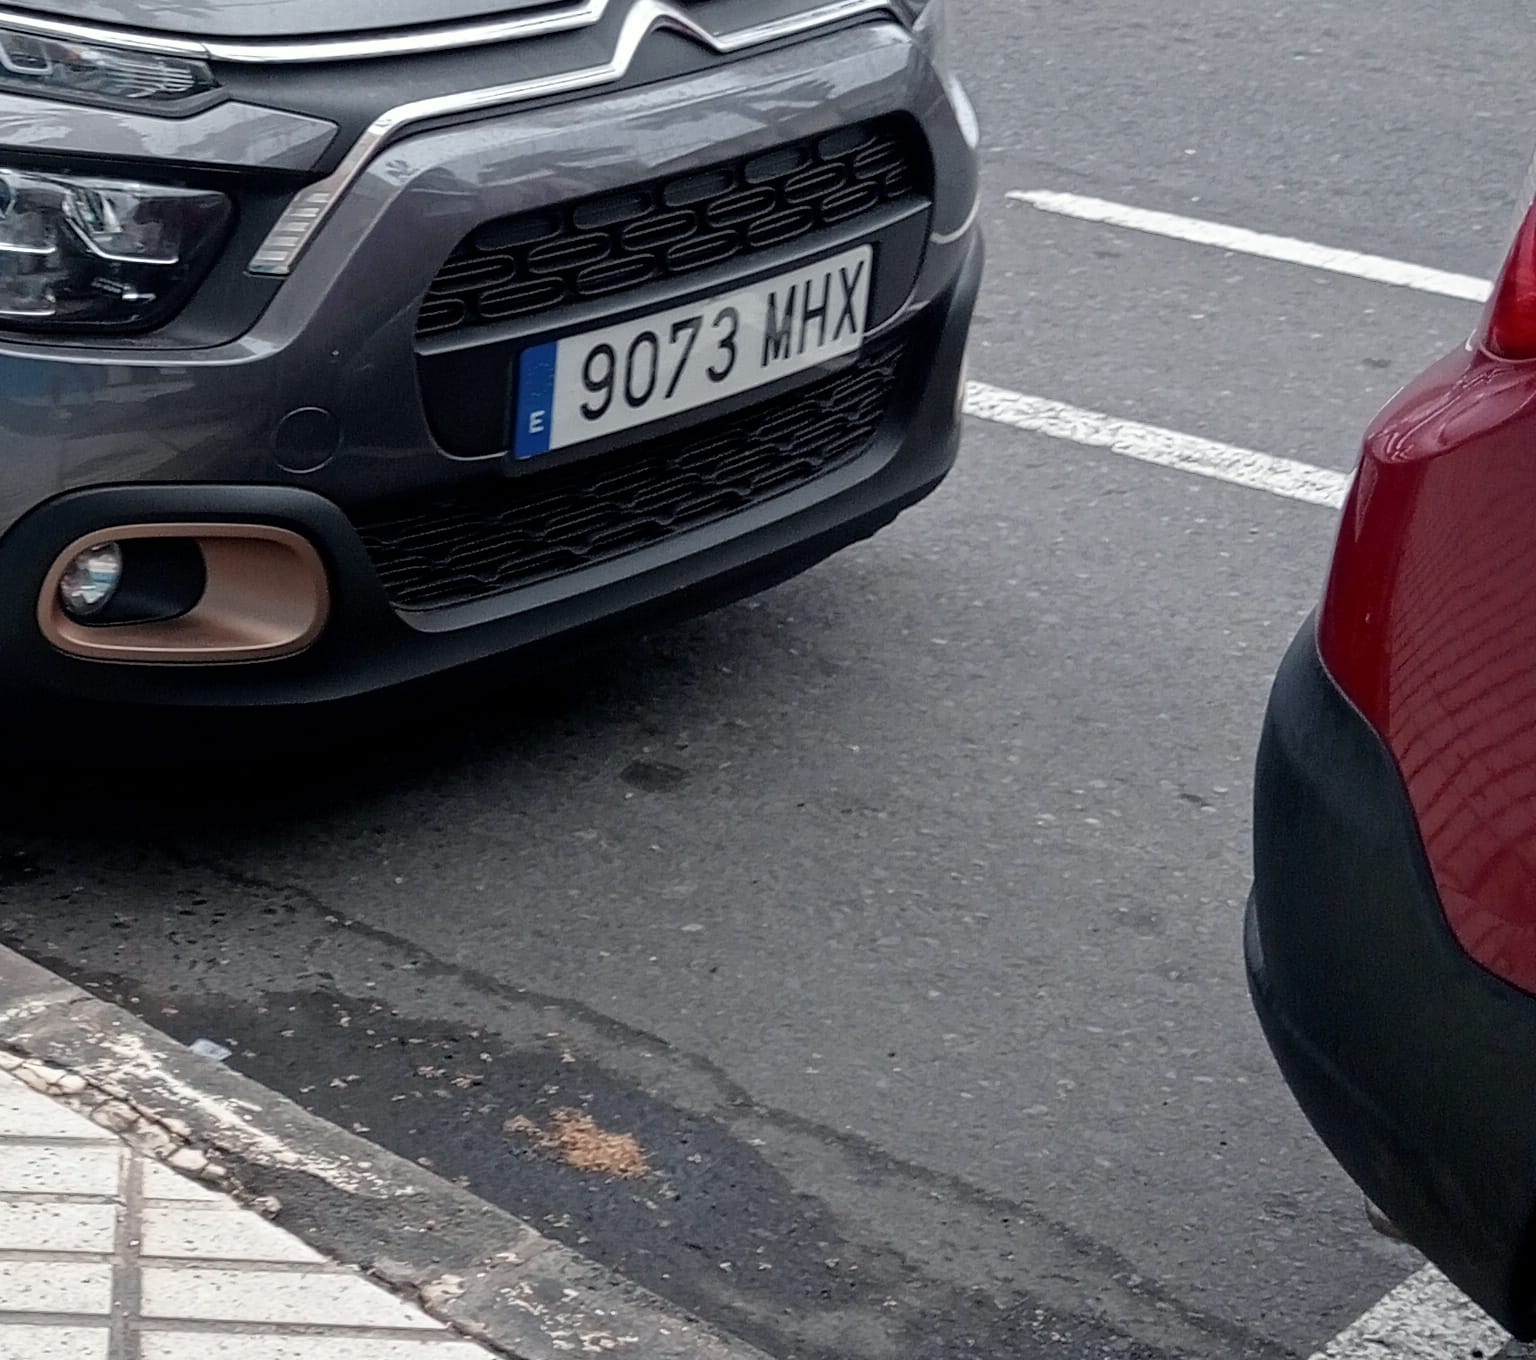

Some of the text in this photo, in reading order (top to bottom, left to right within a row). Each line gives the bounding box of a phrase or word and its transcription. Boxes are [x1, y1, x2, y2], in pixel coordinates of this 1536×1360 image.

[579, 260, 865, 420] 9073 MHX
[529, 410, 545, 433] E
